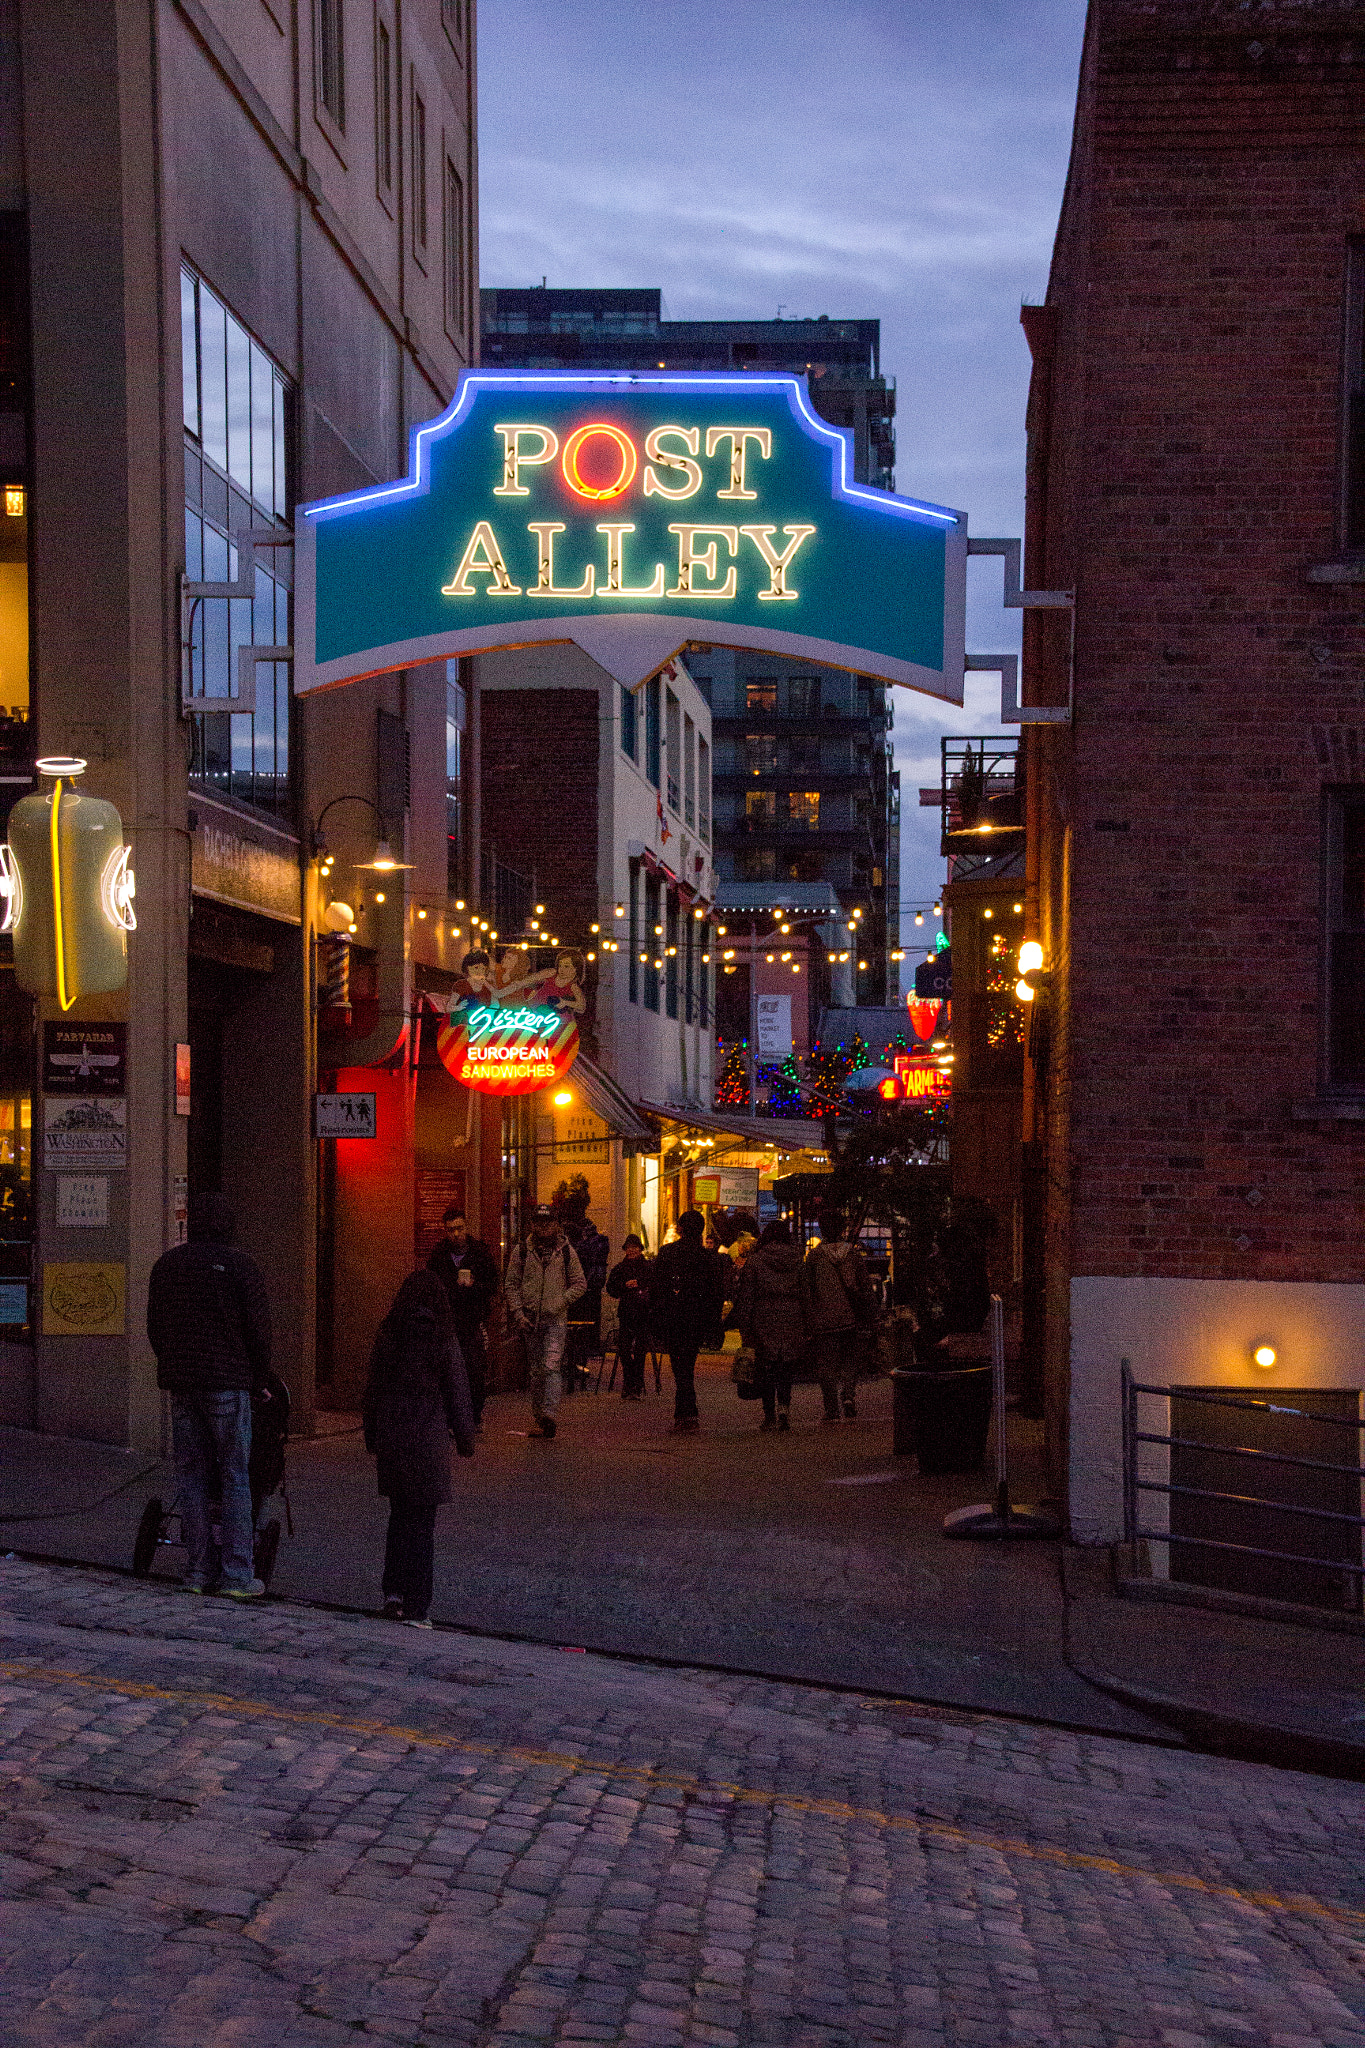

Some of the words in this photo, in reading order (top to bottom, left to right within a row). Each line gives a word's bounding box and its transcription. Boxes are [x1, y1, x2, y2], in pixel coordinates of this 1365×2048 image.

[493, 422, 772, 500] POST
[441, 520, 817, 601] ALLEY
[468, 1005, 561, 1043] Sisters
[467, 1046, 549, 1060] EUROPEAN
[461, 1063, 556, 1079] SANDWICHES
[320, 1126, 370, 1134] Restrooms
[46, 1133, 125, 1149] WASHINGTON
